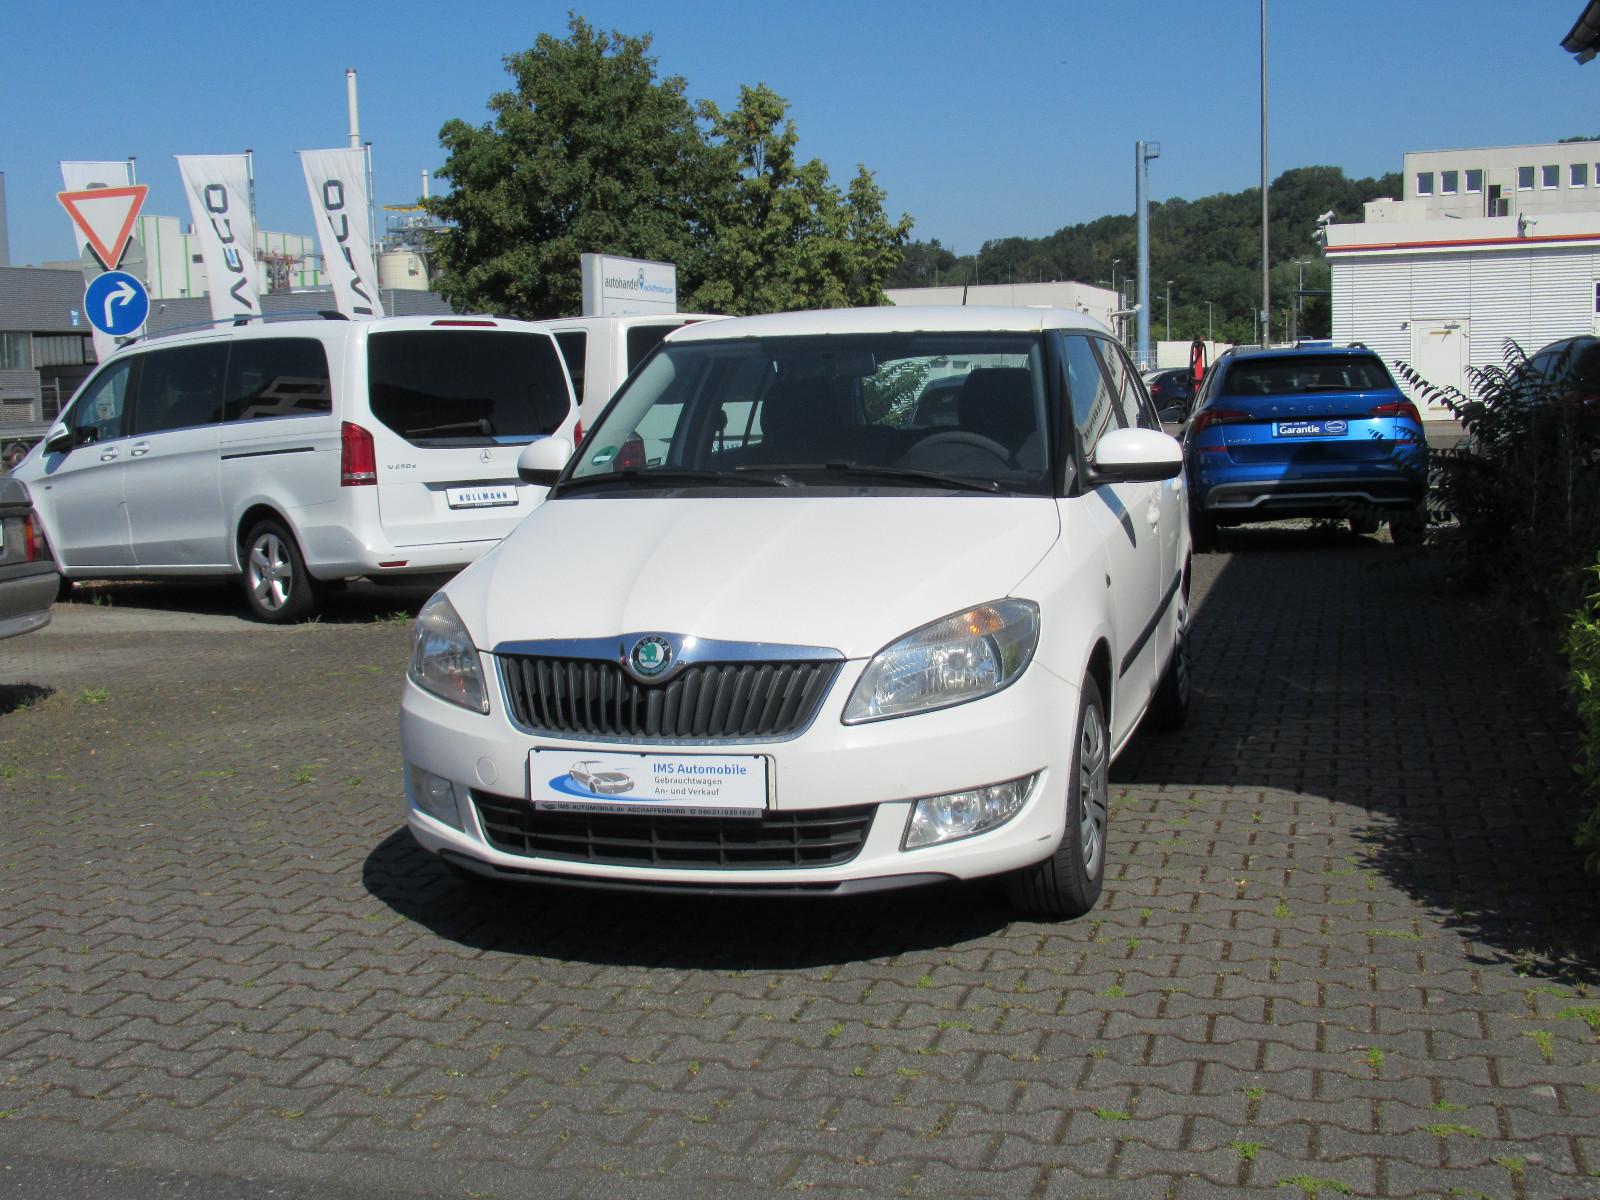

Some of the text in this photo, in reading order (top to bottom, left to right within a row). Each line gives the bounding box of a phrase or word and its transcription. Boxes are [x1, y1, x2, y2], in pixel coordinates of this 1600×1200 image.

[1279, 424, 1320, 434] Garantie
[653, 763, 747, 775] IMS Automobile
[654, 776, 722, 786] Gebrauchtwagen
[654, 786, 720, 796] An- und Verkauf
